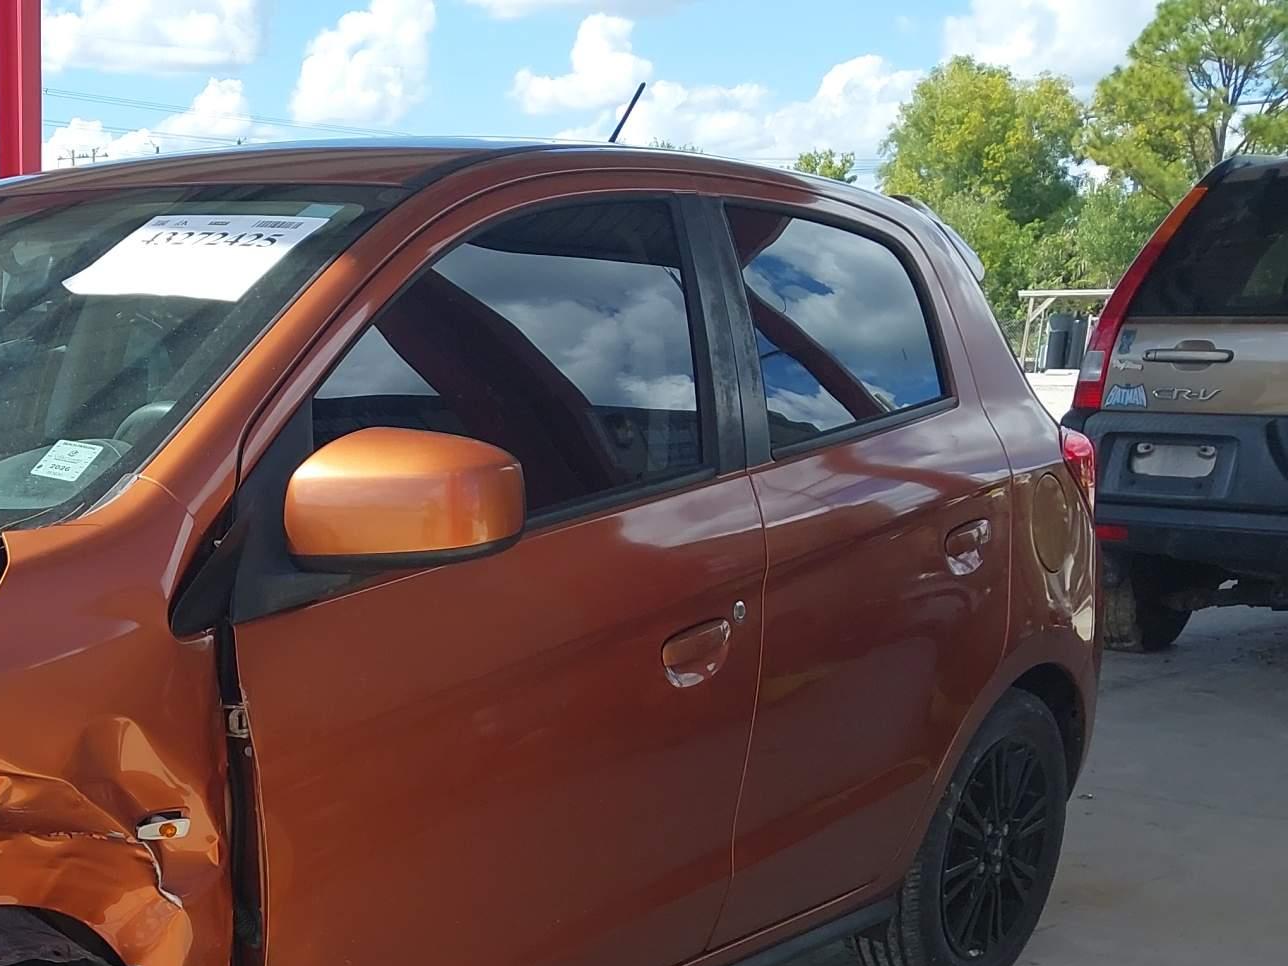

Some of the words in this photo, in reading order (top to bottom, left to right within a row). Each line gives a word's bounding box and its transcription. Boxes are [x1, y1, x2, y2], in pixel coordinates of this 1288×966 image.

[141, 231, 285, 248] 43272425
[1105, 385, 1148, 408] BATMAN
[1152, 387, 1223, 401] CR-V
[49, 463, 71, 472] 2026
